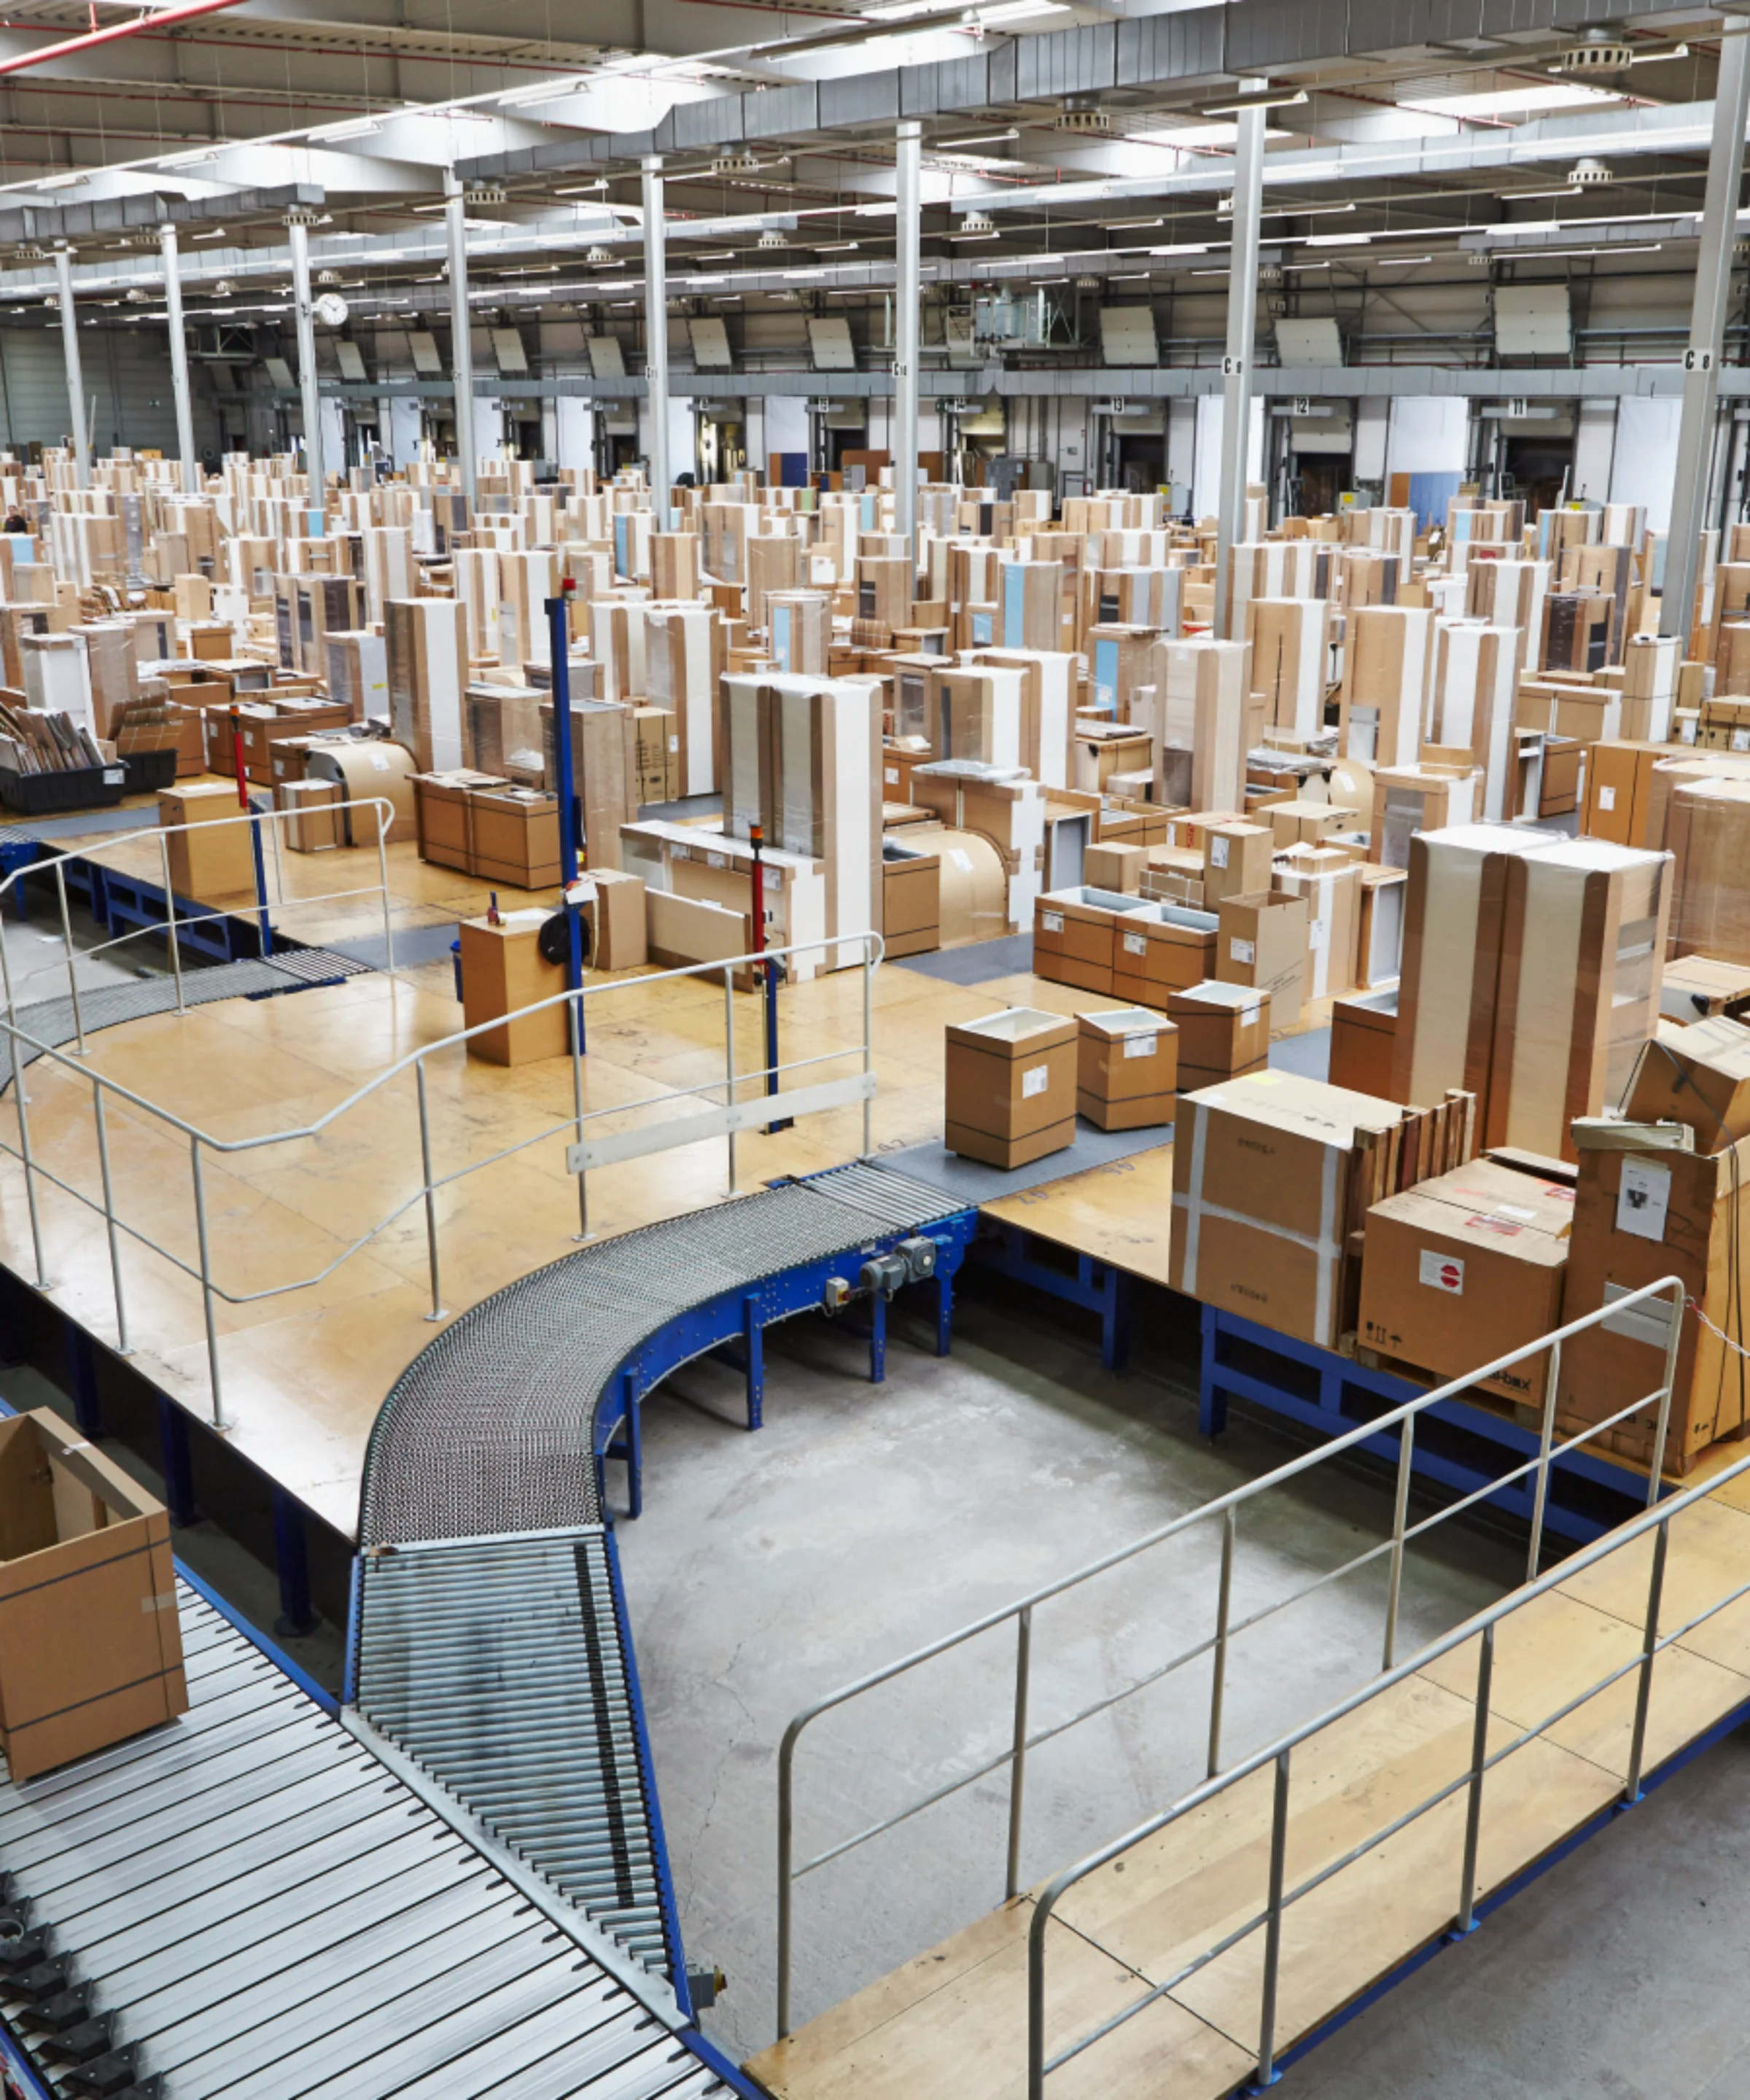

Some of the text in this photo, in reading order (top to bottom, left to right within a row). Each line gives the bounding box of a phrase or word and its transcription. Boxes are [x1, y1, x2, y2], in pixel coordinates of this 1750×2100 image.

[1225, 357, 1231, 374] C
[1686, 350, 1694, 370] C
[1296, 397, 1307, 413] 12
[1514, 398, 1522, 415] 11
